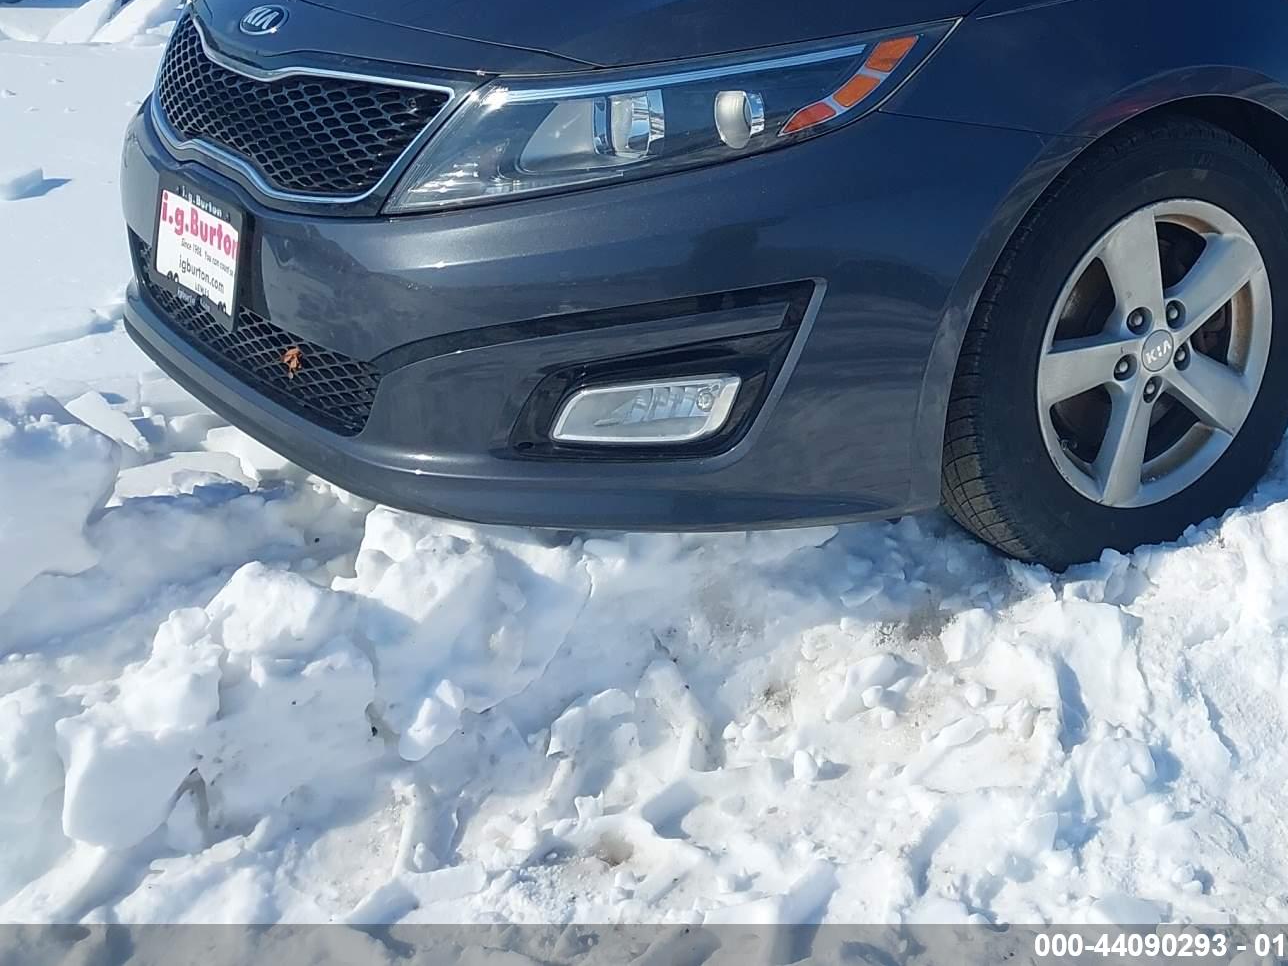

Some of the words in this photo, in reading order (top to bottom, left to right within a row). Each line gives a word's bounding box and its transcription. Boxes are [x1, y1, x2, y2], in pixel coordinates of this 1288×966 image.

[243, 7, 280, 30] KIA
[179, 254, 224, 294] igburton.com
[1145, 340, 1172, 364] KIA
